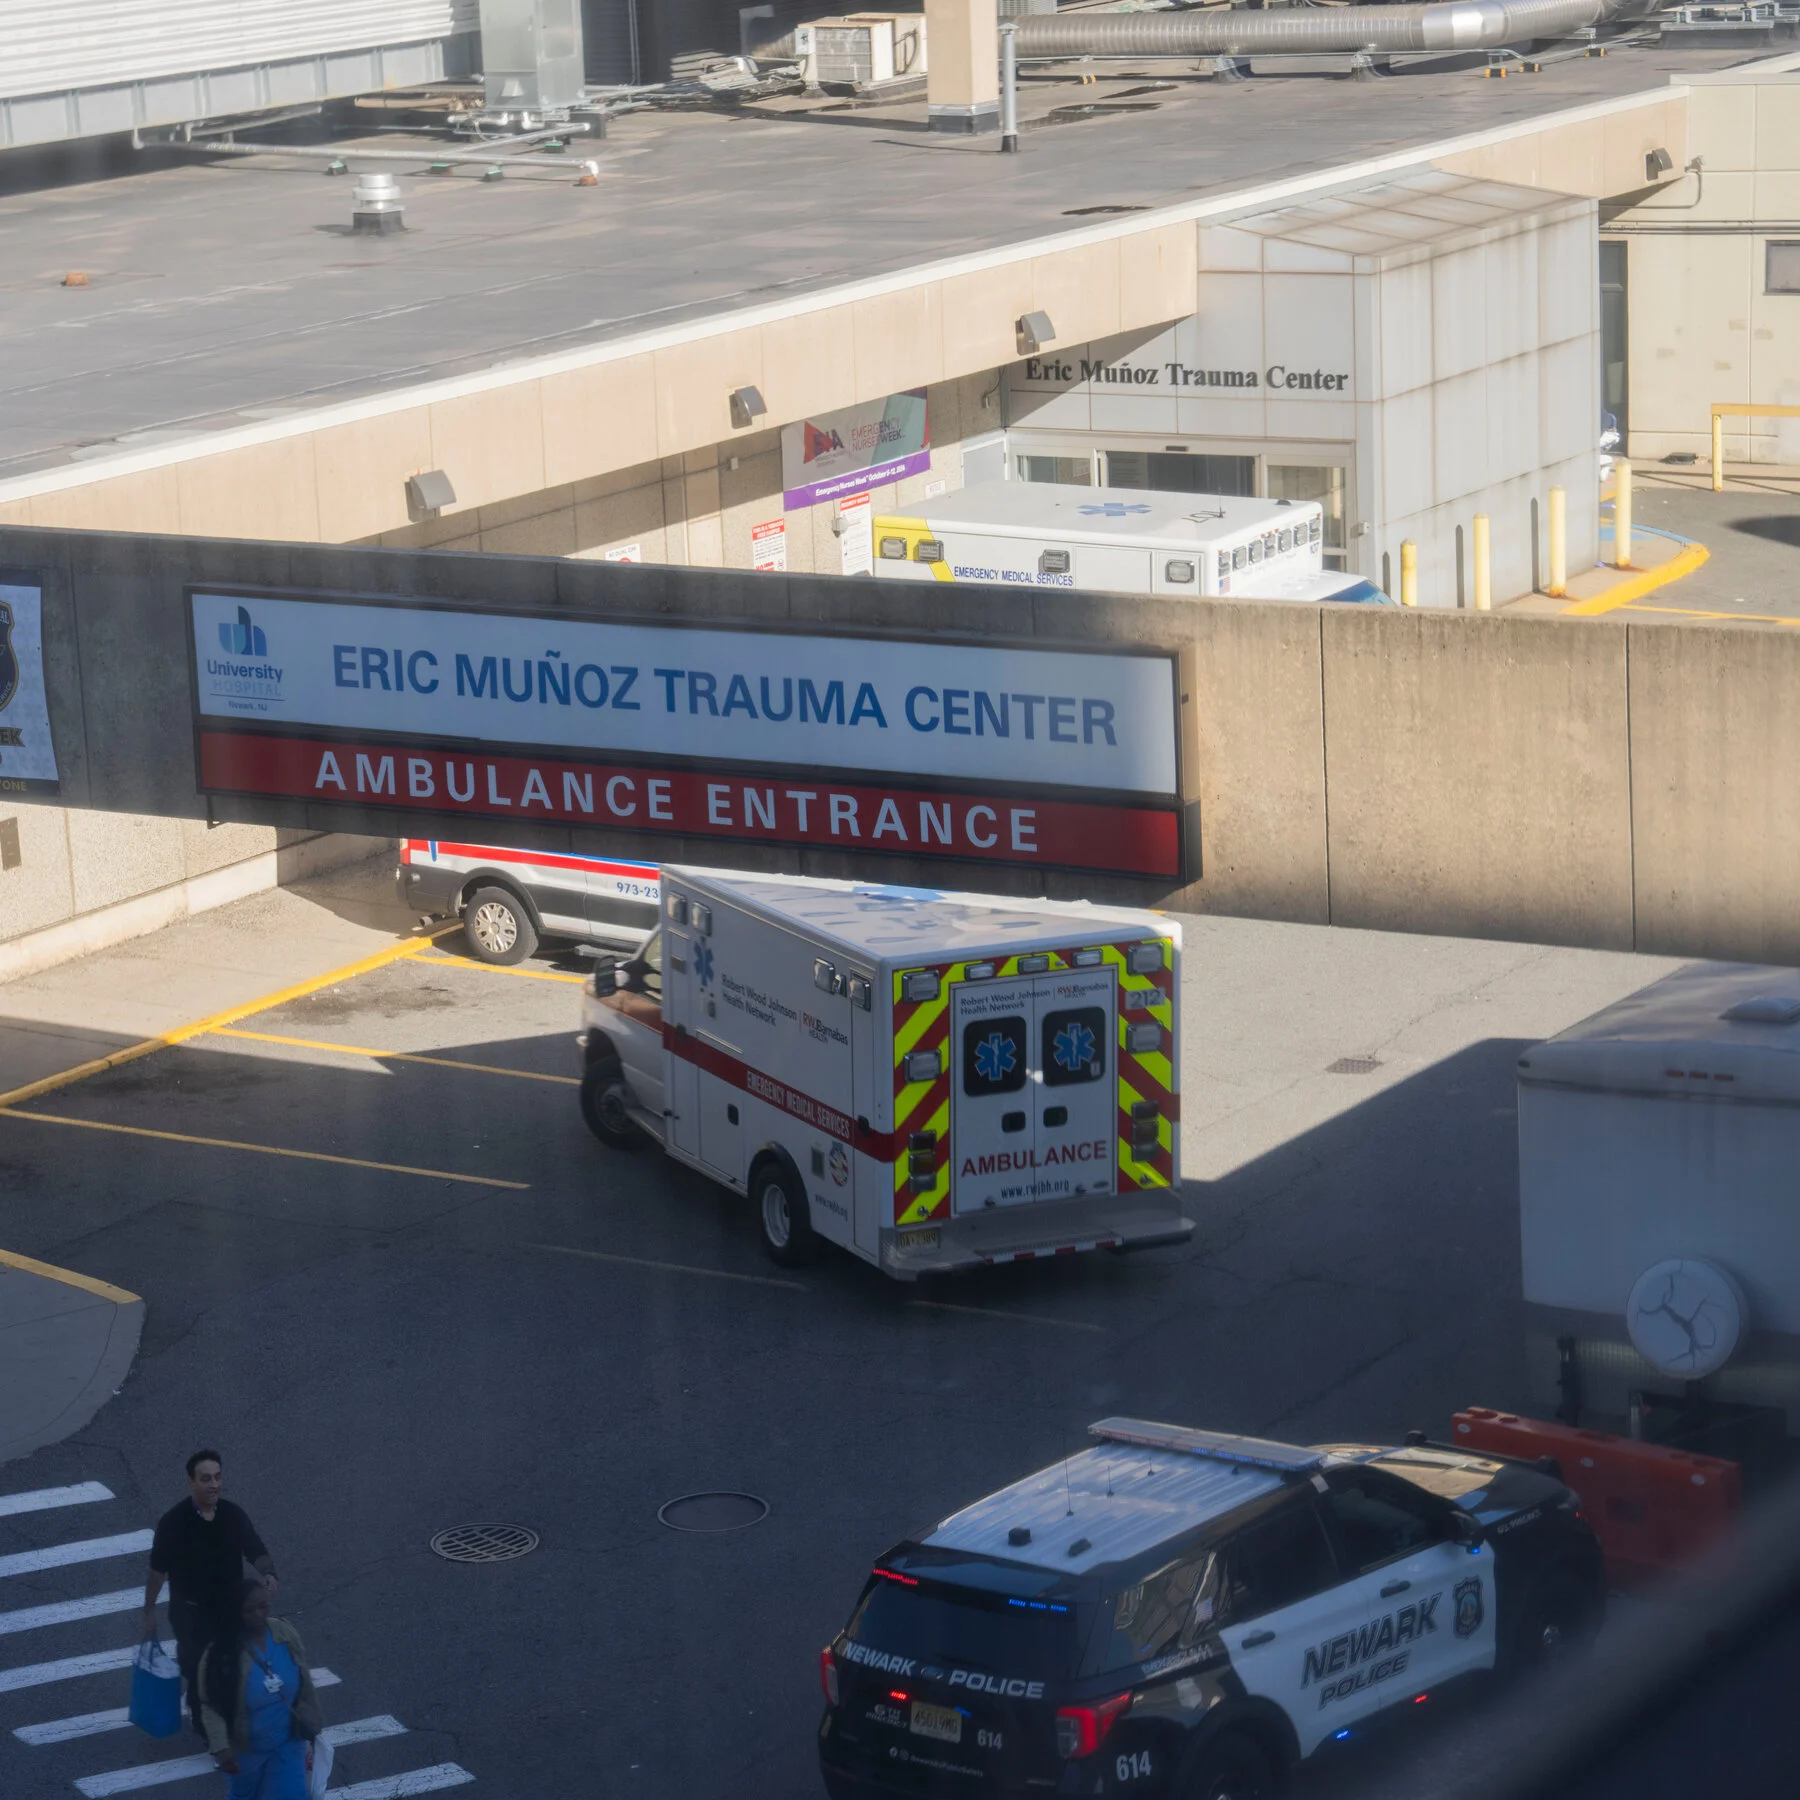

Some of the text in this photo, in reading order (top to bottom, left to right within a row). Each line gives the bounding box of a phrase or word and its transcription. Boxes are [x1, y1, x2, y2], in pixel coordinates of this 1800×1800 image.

[1026, 358, 1349, 391] Eric Muñoz Trauma Center
[851, 417, 900, 438] EMERGENCY
[815, 484, 841, 497] Emergency
[954, 566, 1073, 586] EMERGENCY MEDICAL SERVICES
[207, 659, 283, 683] University
[213, 680, 282, 696] HOSPITAL
[333, 645, 1119, 747] ERIC MUÑOZ TRAUMA CENTER
[315, 750, 1039, 853] AMBULANCE ENTRANCE
[616, 881, 659, 899] 973-23
[721, 973, 797, 1021] Robert Wood Johnson
[960, 989, 1050, 1007] Robert Wood Johnson
[960, 1001, 1025, 1016] Health Network
[1129, 989, 1162, 1008] 212
[747, 1070, 850, 1139] EMERGENCY MEDICAL SERVICES
[961, 1140, 1108, 1177] AMBULANCE
[1001, 1179, 1070, 1200] www.rwjbh.org
[1300, 1591, 1443, 1691] NEWARK
[843, 1640, 1046, 1699] NEWARK POLICE
[1318, 1649, 1412, 1711] POLICE
[977, 1729, 1003, 1750] 614
[1116, 1750, 1152, 1782] 614
